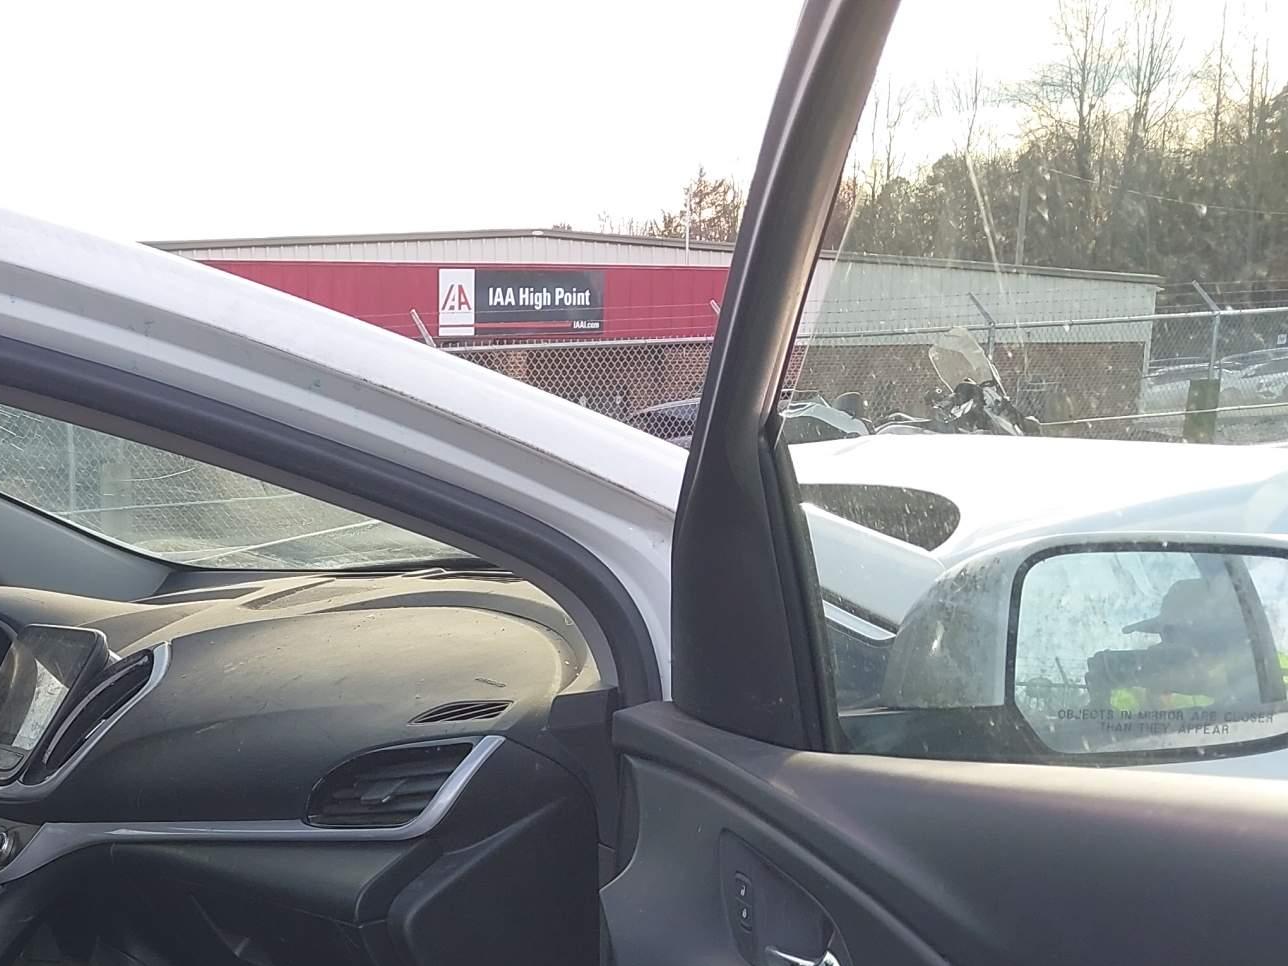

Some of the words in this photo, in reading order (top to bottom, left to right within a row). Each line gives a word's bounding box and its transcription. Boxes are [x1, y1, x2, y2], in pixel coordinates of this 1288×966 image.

[488, 287, 516, 306] IAA
[519, 287, 551, 310] High
[555, 287, 591, 306] Point
[1057, 708, 1114, 720] OBJECTS
[1120, 709, 1133, 720] IN
[1137, 710, 1184, 721] MIRROR
[1192, 710, 1217, 721] ARE
[1223, 710, 1274, 724] CLOSER
[1099, 721, 1132, 733] THAN
[1138, 722, 1171, 734] THEY
[1177, 723, 1230, 735] APPEAR
